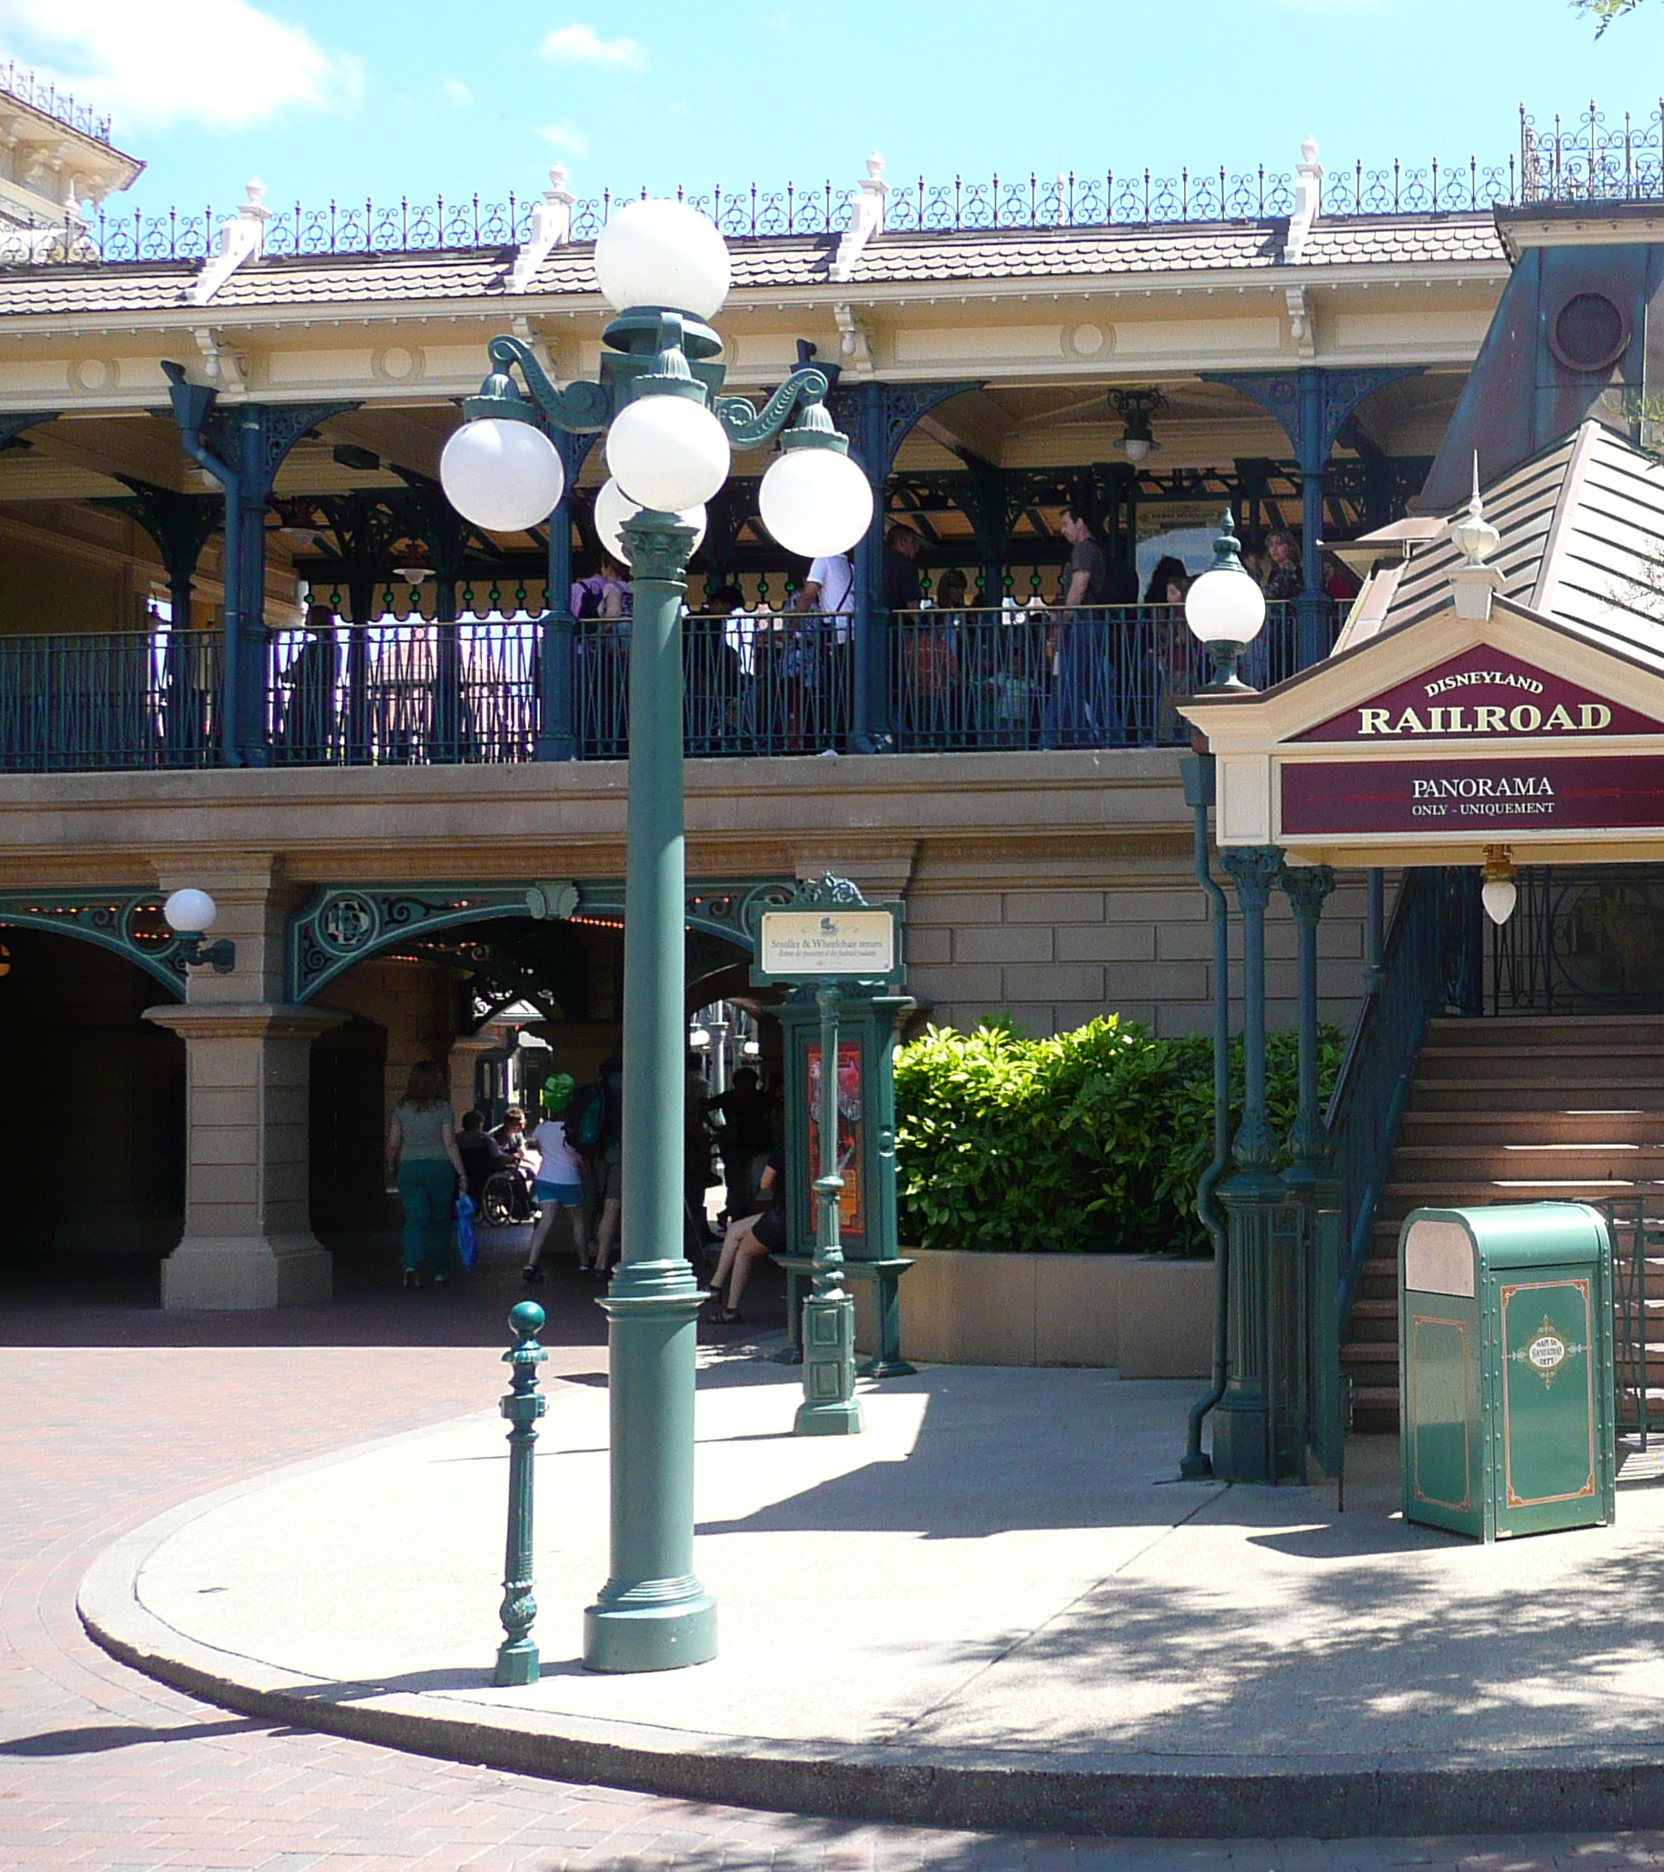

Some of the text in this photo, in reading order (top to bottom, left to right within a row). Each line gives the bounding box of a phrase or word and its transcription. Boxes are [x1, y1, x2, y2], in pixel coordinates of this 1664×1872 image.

[1423, 671, 1544, 698] DISNEYLAND
[1357, 703, 1612, 734] RAILROAD
[1412, 777, 1555, 799] PANORAMA
[1411, 804, 1449, 816] ONLY
[1459, 803, 1556, 816] UNIQUEMENT
